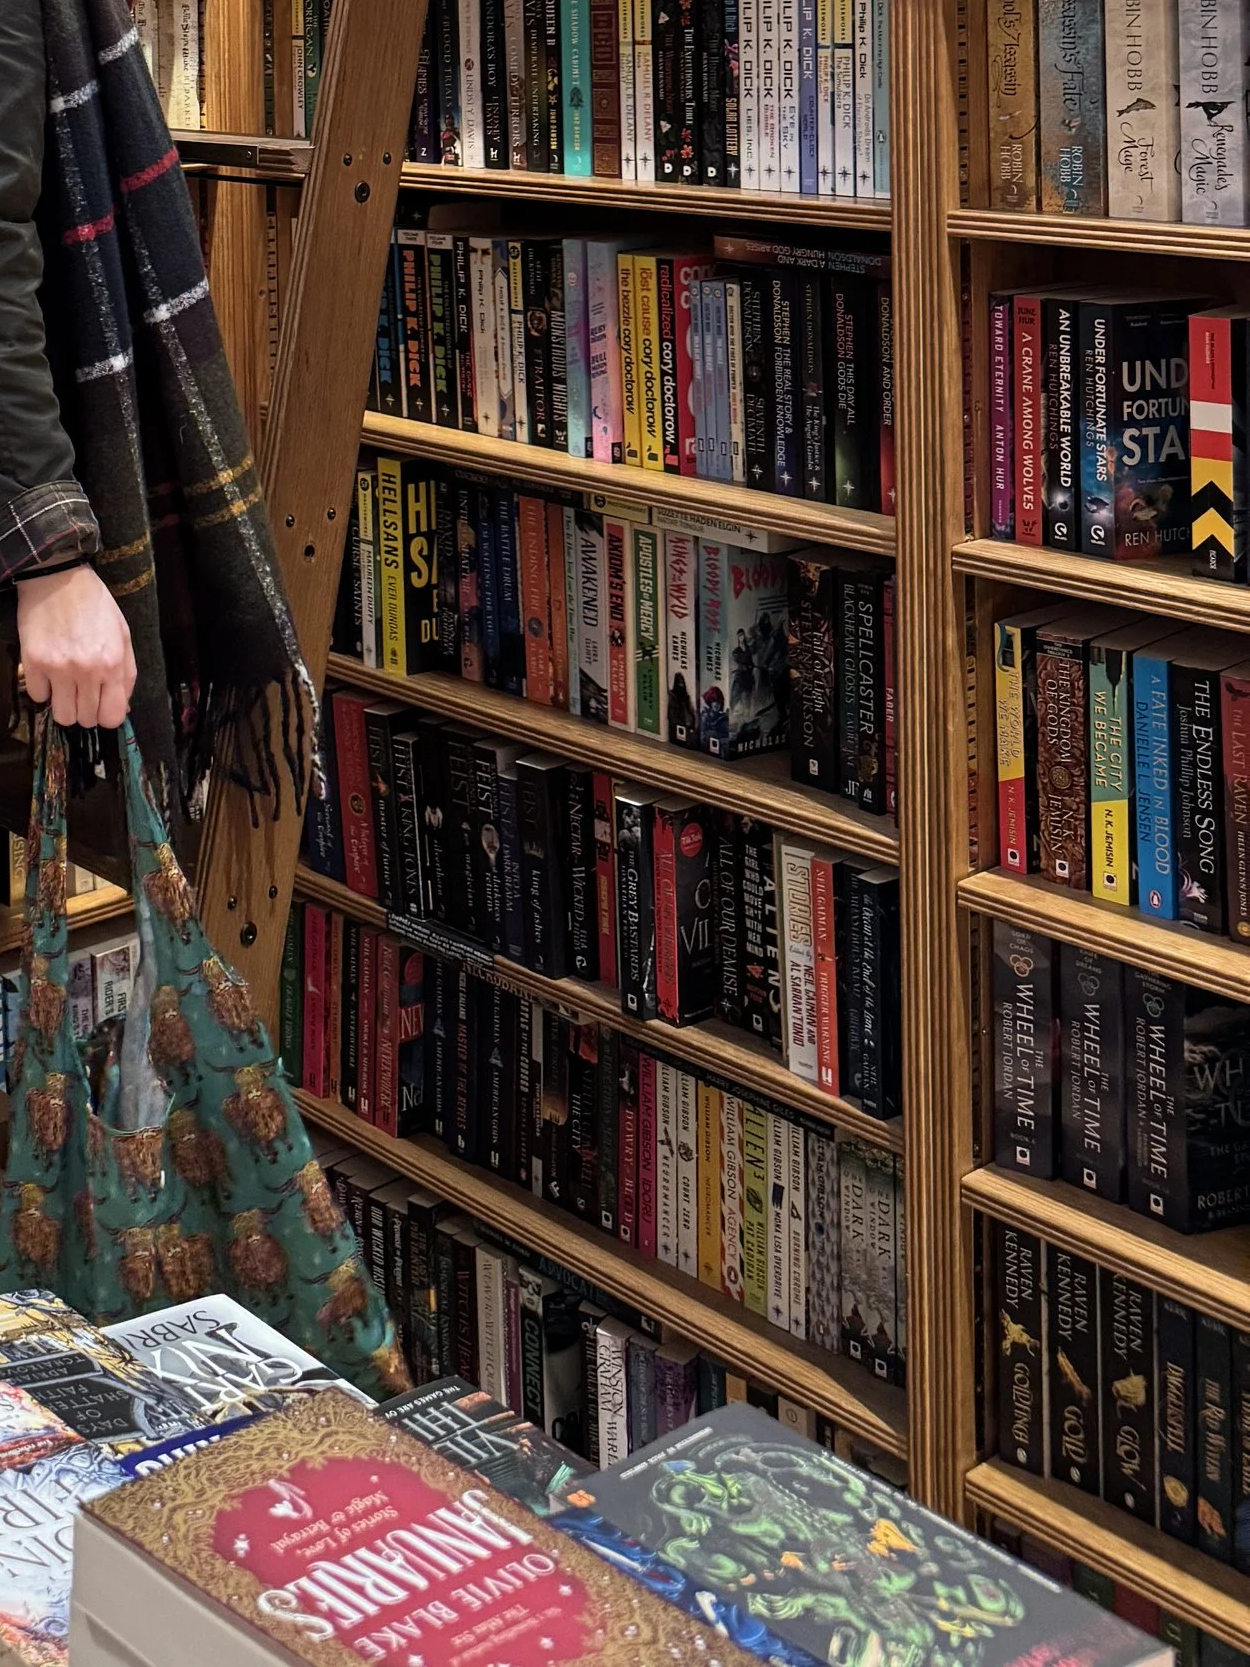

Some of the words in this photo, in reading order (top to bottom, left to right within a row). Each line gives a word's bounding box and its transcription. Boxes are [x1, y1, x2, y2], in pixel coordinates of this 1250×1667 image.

[1125, 35, 1143, 91] HOBB
[641, 338, 653, 369] cory
[1022, 341, 1033, 392] CRANE
[642, 370, 658, 438] doctorow
[1022, 454, 1034, 511] WOLVES
[379, 470, 400, 570] HELLSANS
[1193, 723, 1213, 811] ENDLESS
[1195, 814, 1215, 874] SONG
[1016, 984, 1035, 1057] WHEEL
[1016, 1075, 1035, 1130] TIME
[1005, 1229, 1019, 1309] KENNEDY
[1019, 1246, 1034, 1302] RAVEN
[256, 1489, 534, 1642] JANUARIES
[451, 1553, 556, 1612] OLIVIE
[353, 1601, 459, 1661] BLAKE
